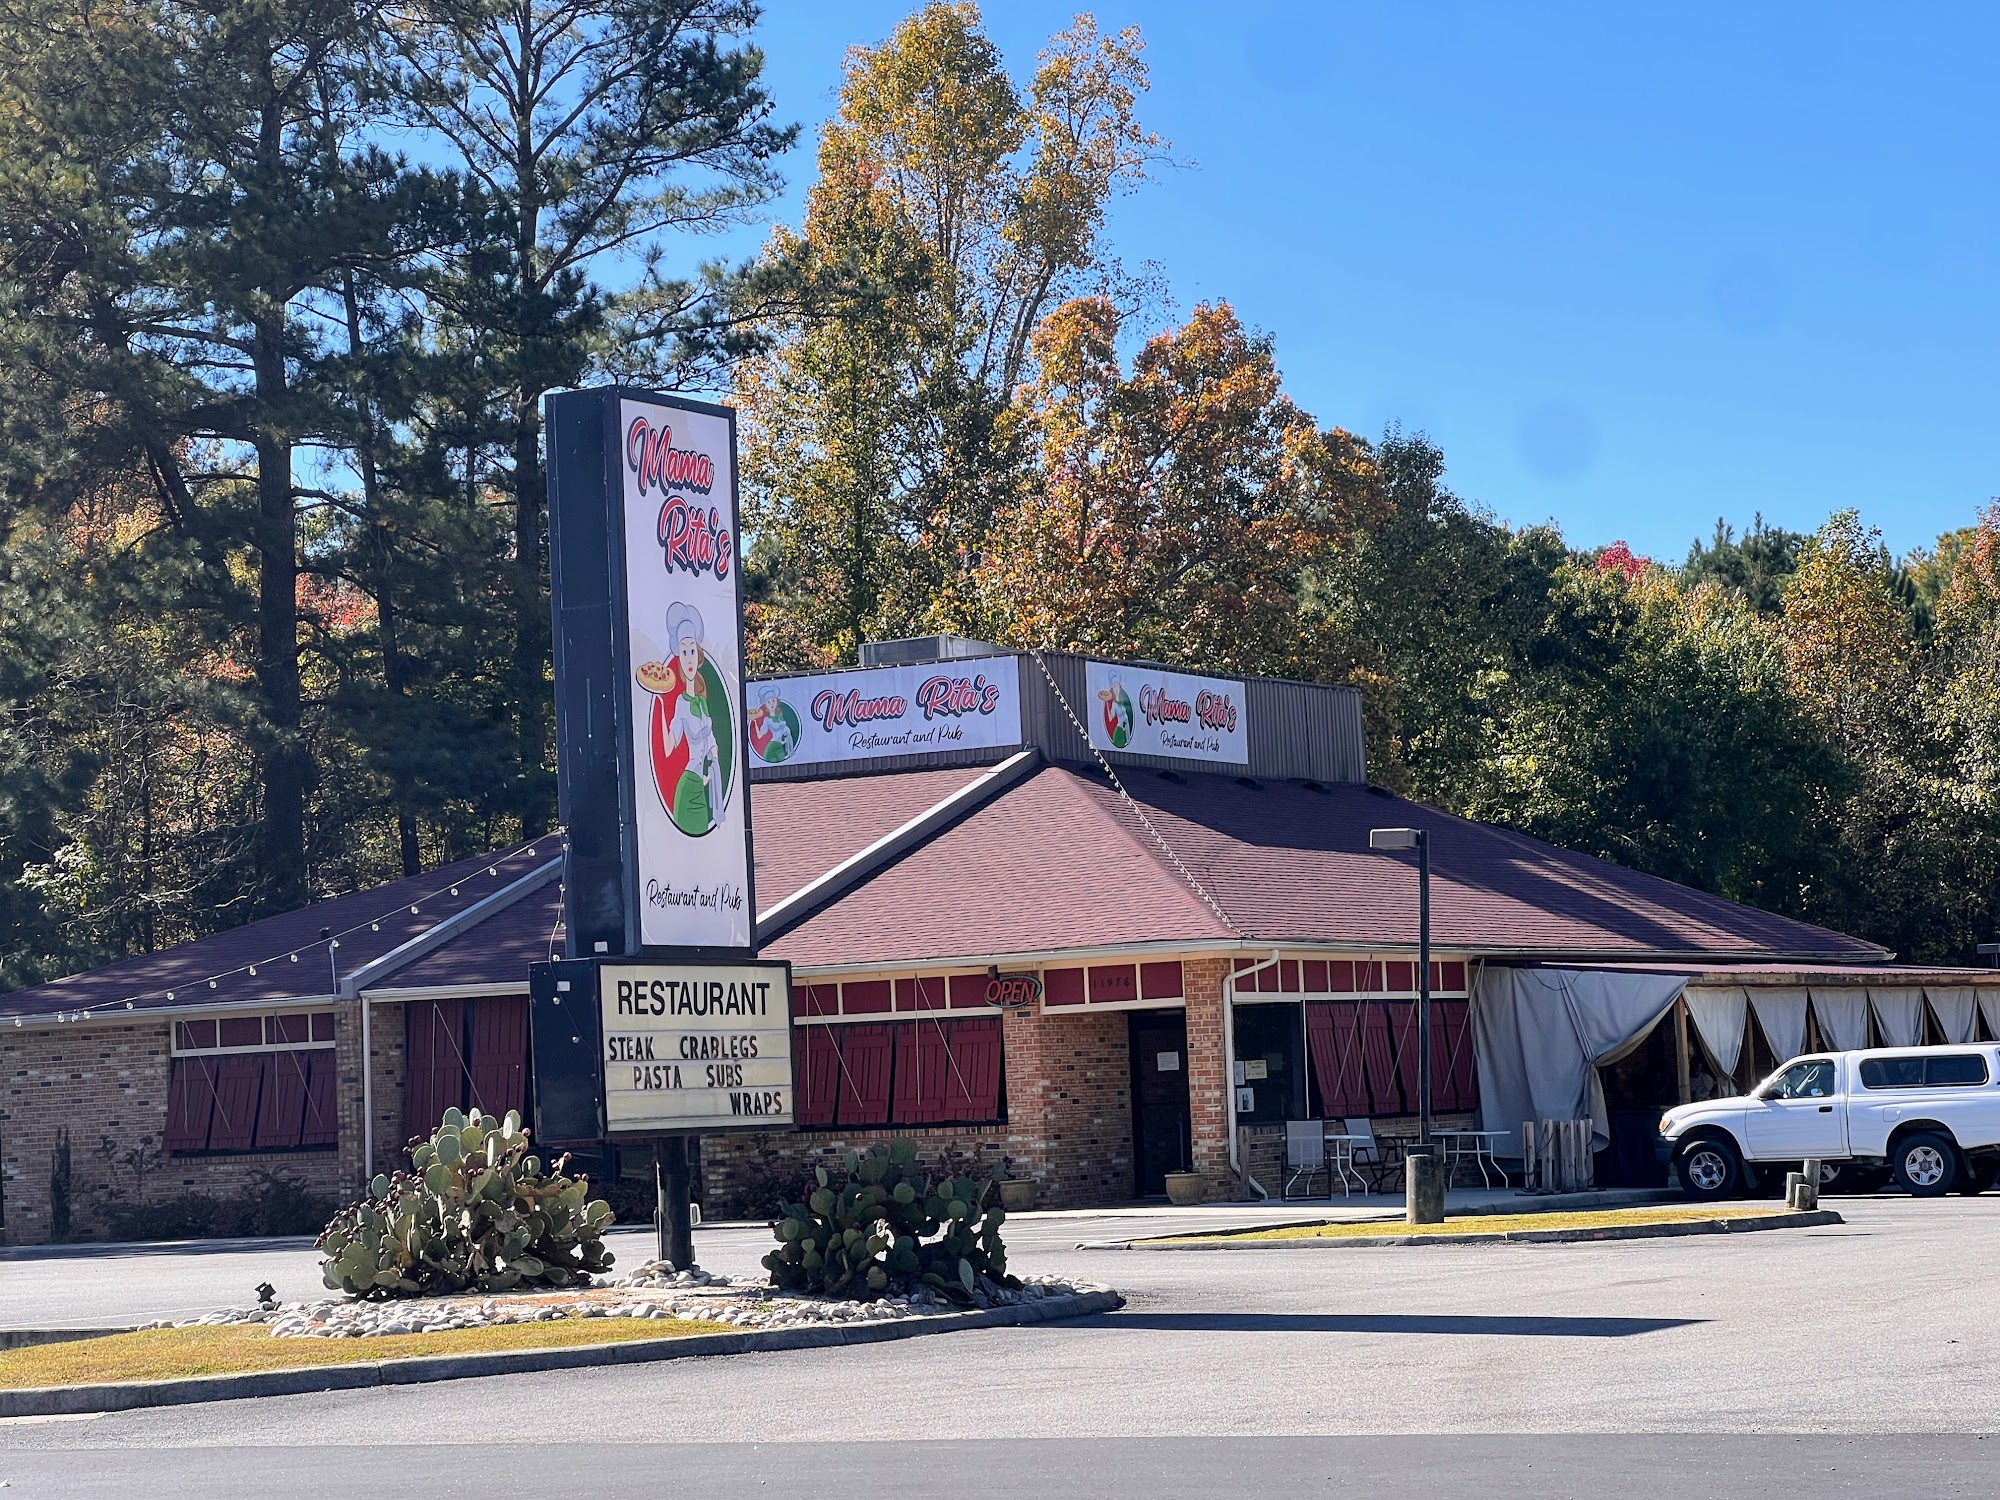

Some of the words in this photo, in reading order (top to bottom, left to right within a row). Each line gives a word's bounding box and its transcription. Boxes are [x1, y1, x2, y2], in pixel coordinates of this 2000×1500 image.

[627, 416, 714, 497] Mama
[657, 495, 731, 581] Rita's
[811, 688, 907, 732] Mama
[916, 674, 999, 721] Rita's
[1139, 683, 1191, 726] Mama
[1196, 689, 1237, 733] Rita's
[849, 730, 912, 750] Restaurant
[912, 727, 934, 744] and
[938, 723, 964, 743] Pub
[1161, 730, 1194, 751] Restaurant
[1194, 737, 1206, 752] and
[1207, 736, 1219, 752] Pub
[646, 878, 699, 910] Restaurant
[700, 887, 718, 912] and
[721, 883, 742, 912] Pub
[617, 980, 770, 1016] RESTAURANT
[986, 980, 1036, 1003] OPEN
[608, 1036, 655, 1060] STEAK
[633, 1066, 682, 1089] PASTA
[706, 1064, 743, 1088] SUBS
[729, 1091, 782, 1116] WRAPS
